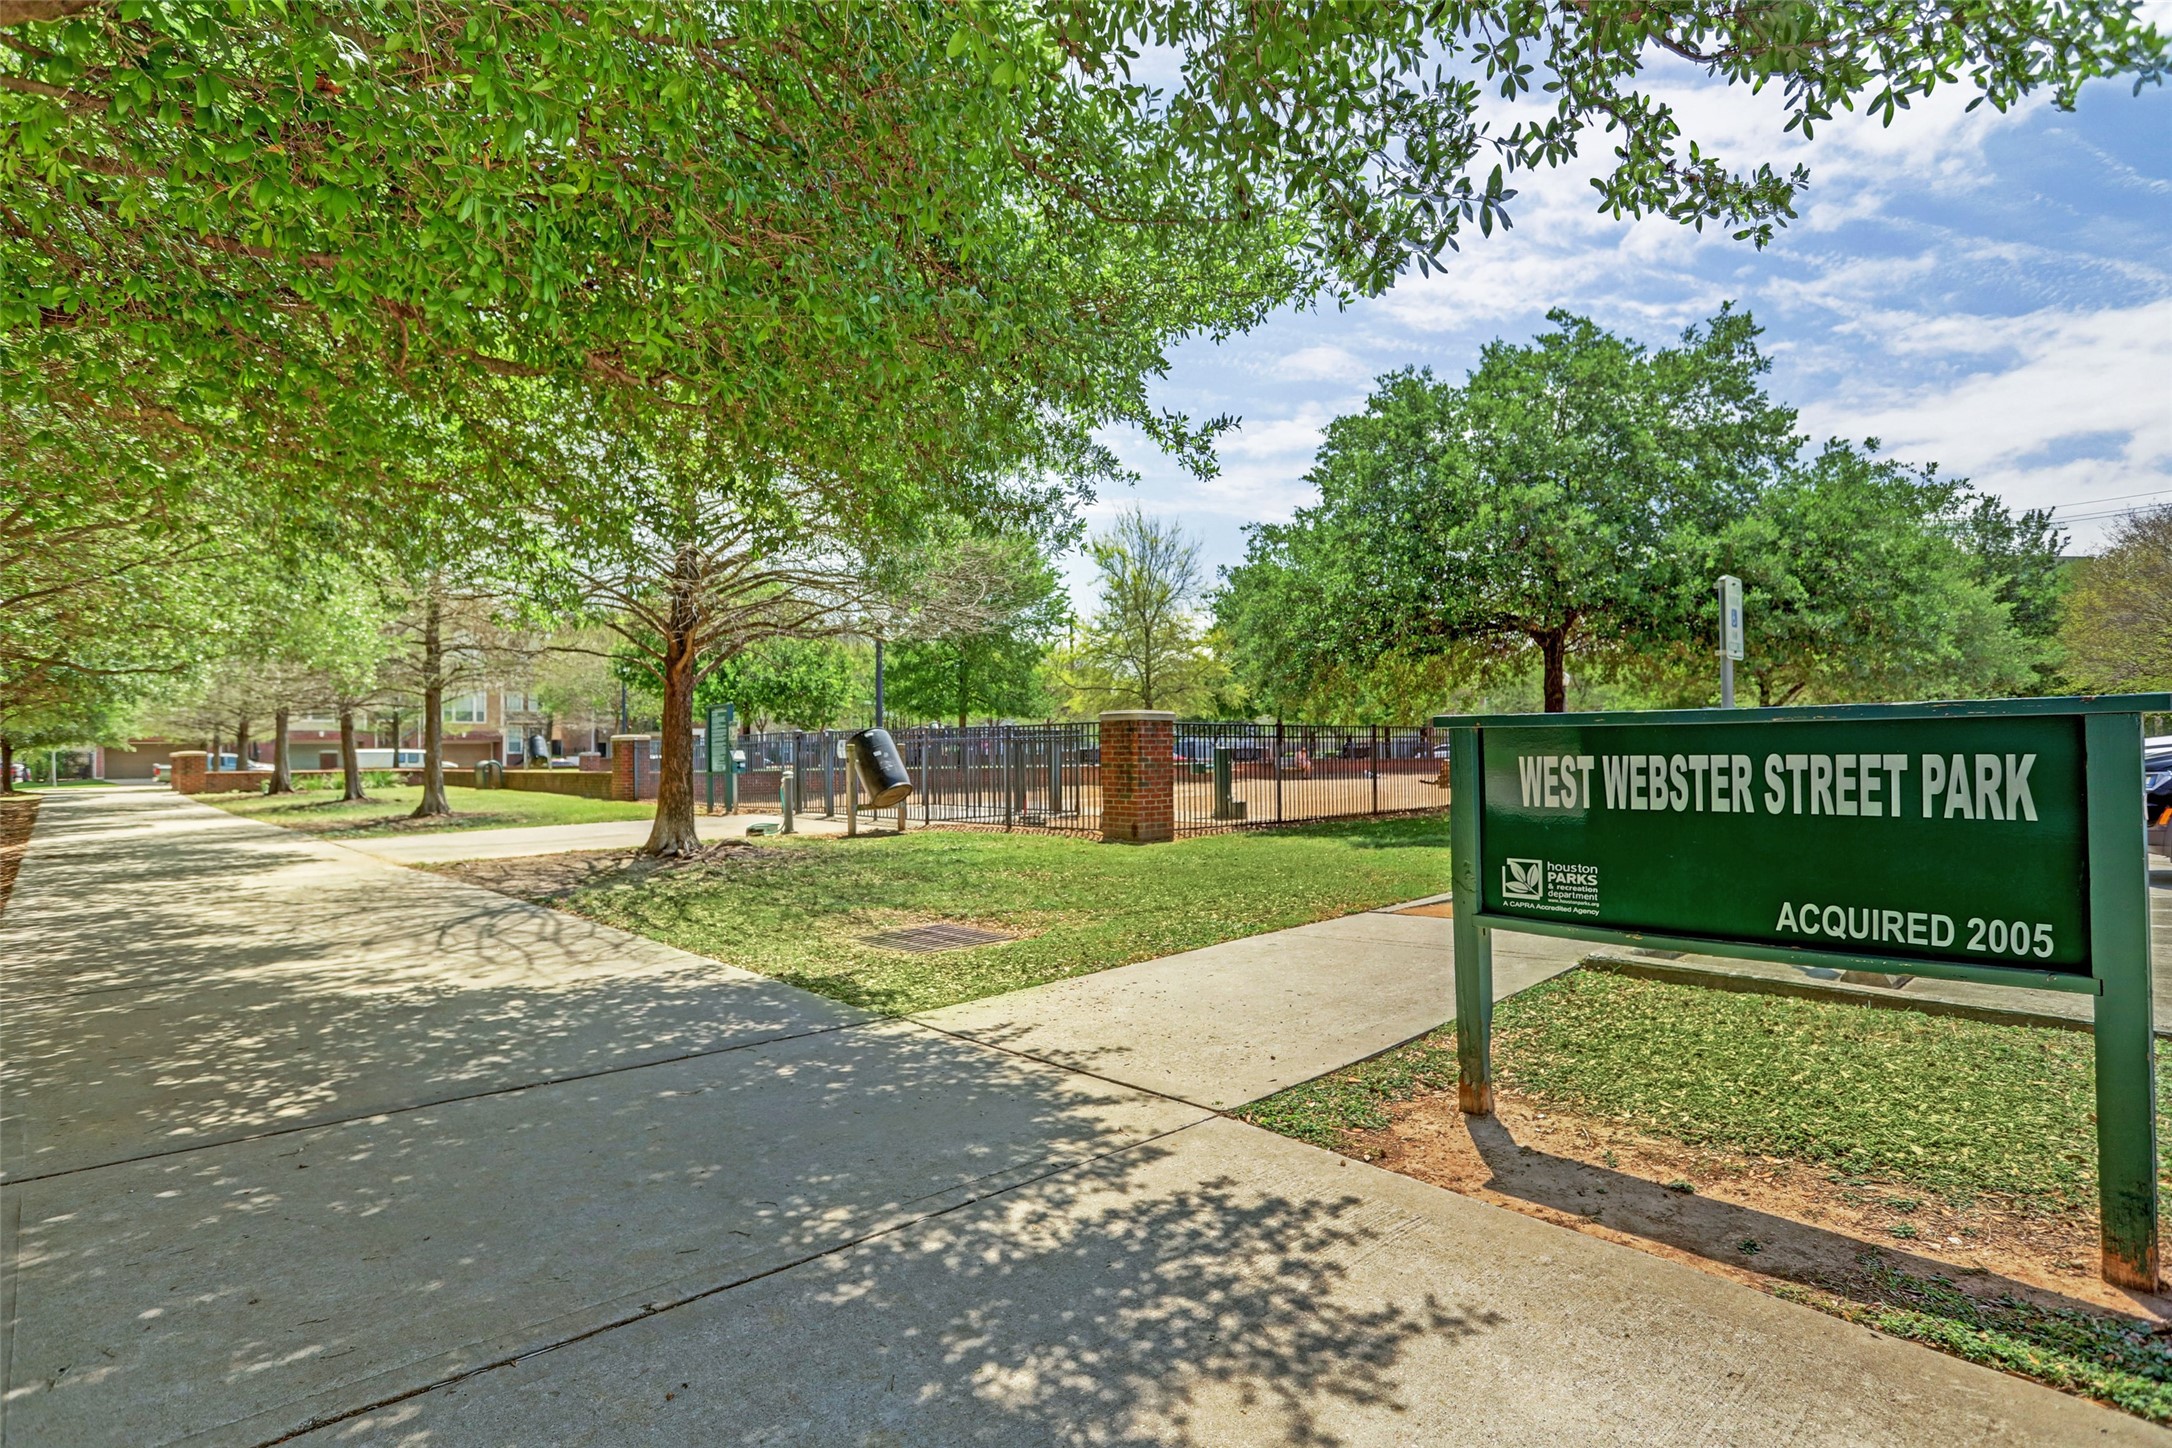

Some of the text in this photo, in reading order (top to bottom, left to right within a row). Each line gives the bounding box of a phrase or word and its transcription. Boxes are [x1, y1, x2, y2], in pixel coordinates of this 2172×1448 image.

[1518, 753, 2039, 822] WEST WEBSTER STREET PARK
[1547, 861, 1598, 874] houston
[1547, 872, 1598, 886] PARKS
[1547, 890, 1598, 901] department
[1556, 884, 1598, 893] recreation
[1509, 901, 1535, 909] CAPRA
[1535, 904, 1572, 912] Accredited
[1573, 907, 1600, 916] Agency
[1775, 901, 2054, 958] ACQUIRED 2005
